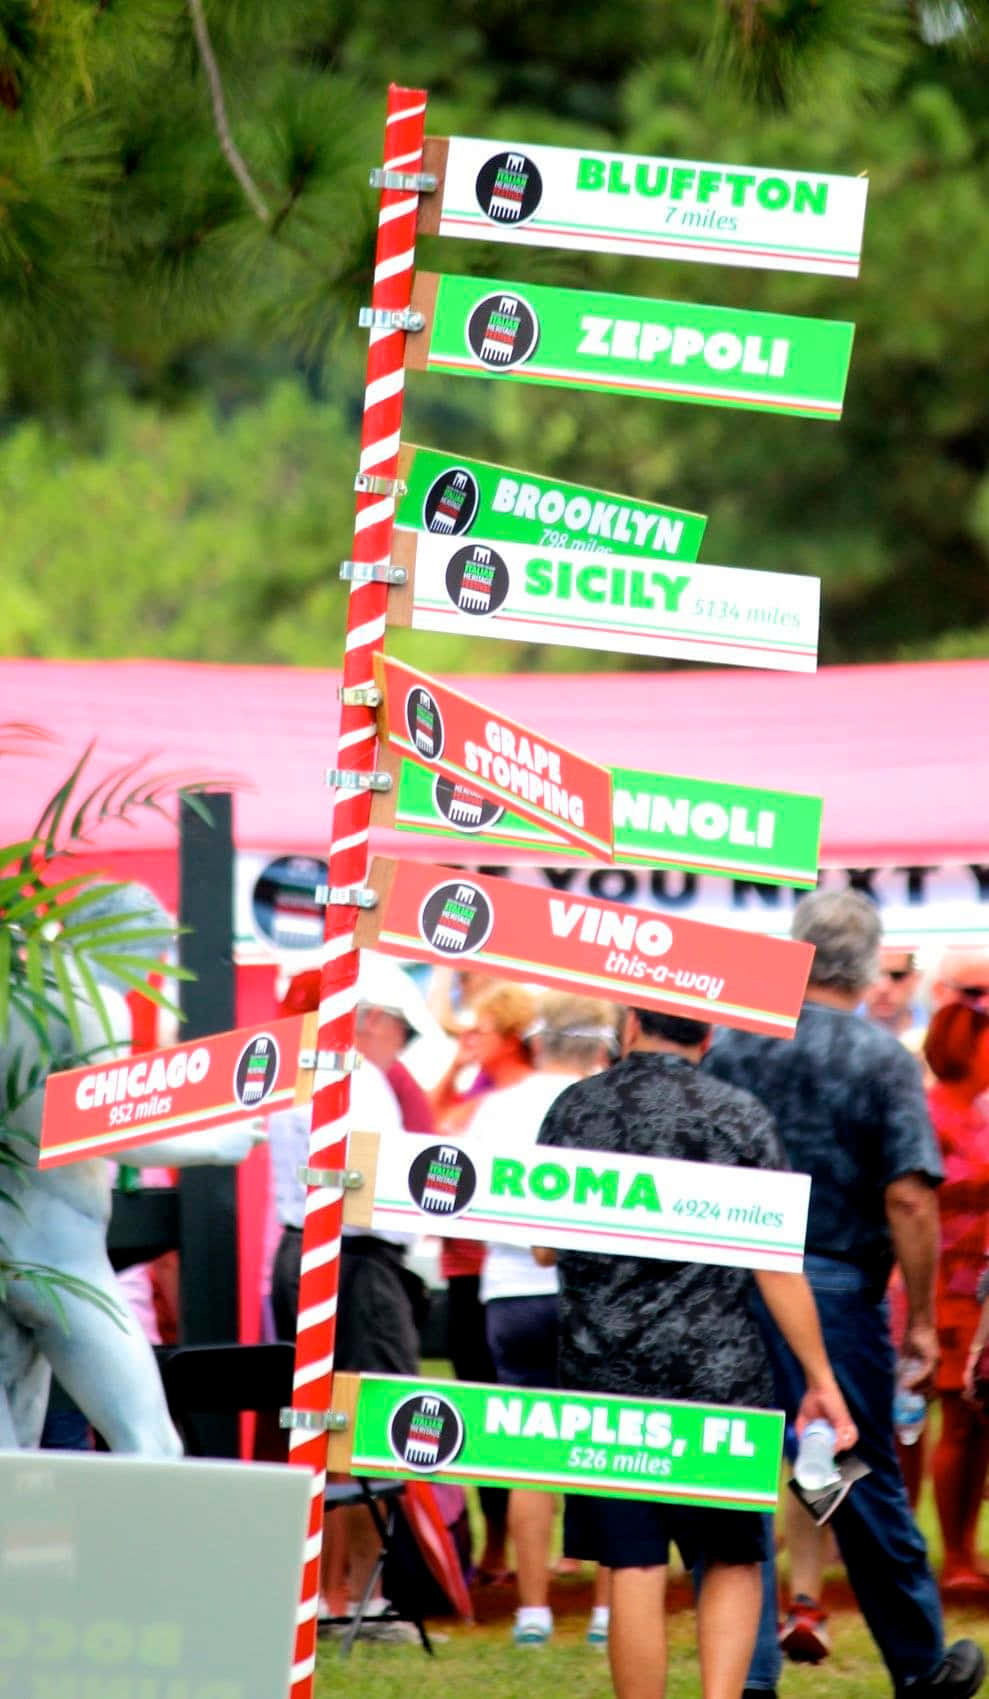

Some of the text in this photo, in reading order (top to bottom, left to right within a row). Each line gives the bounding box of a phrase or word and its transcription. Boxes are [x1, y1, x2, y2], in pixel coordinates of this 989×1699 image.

[576, 157, 829, 215] BLUFFTON
[665, 206, 738, 231] 7 miles
[576, 317, 788, 377] ZEPPOLI
[491, 478, 684, 554] BROOKLYN
[540, 528, 569, 548] 798
[526, 557, 801, 627] SICILY 5134 miles
[485, 720, 562, 785] GRAPE
[464, 740, 585, 827] STOMPING
[613, 789, 776, 849] NNOLI
[731, 866, 939, 906] NXT
[549, 900, 673, 955] VINO
[606, 951, 725, 999] this-a-way
[76, 1047, 210, 1110] CHICAGO
[109, 1095, 172, 1125] 952 miles
[491, 1157, 785, 1229] ROMA 4924 miles
[485, 1398, 755, 1458] NAPLES, FL
[569, 1445, 673, 1474] 526 miles
